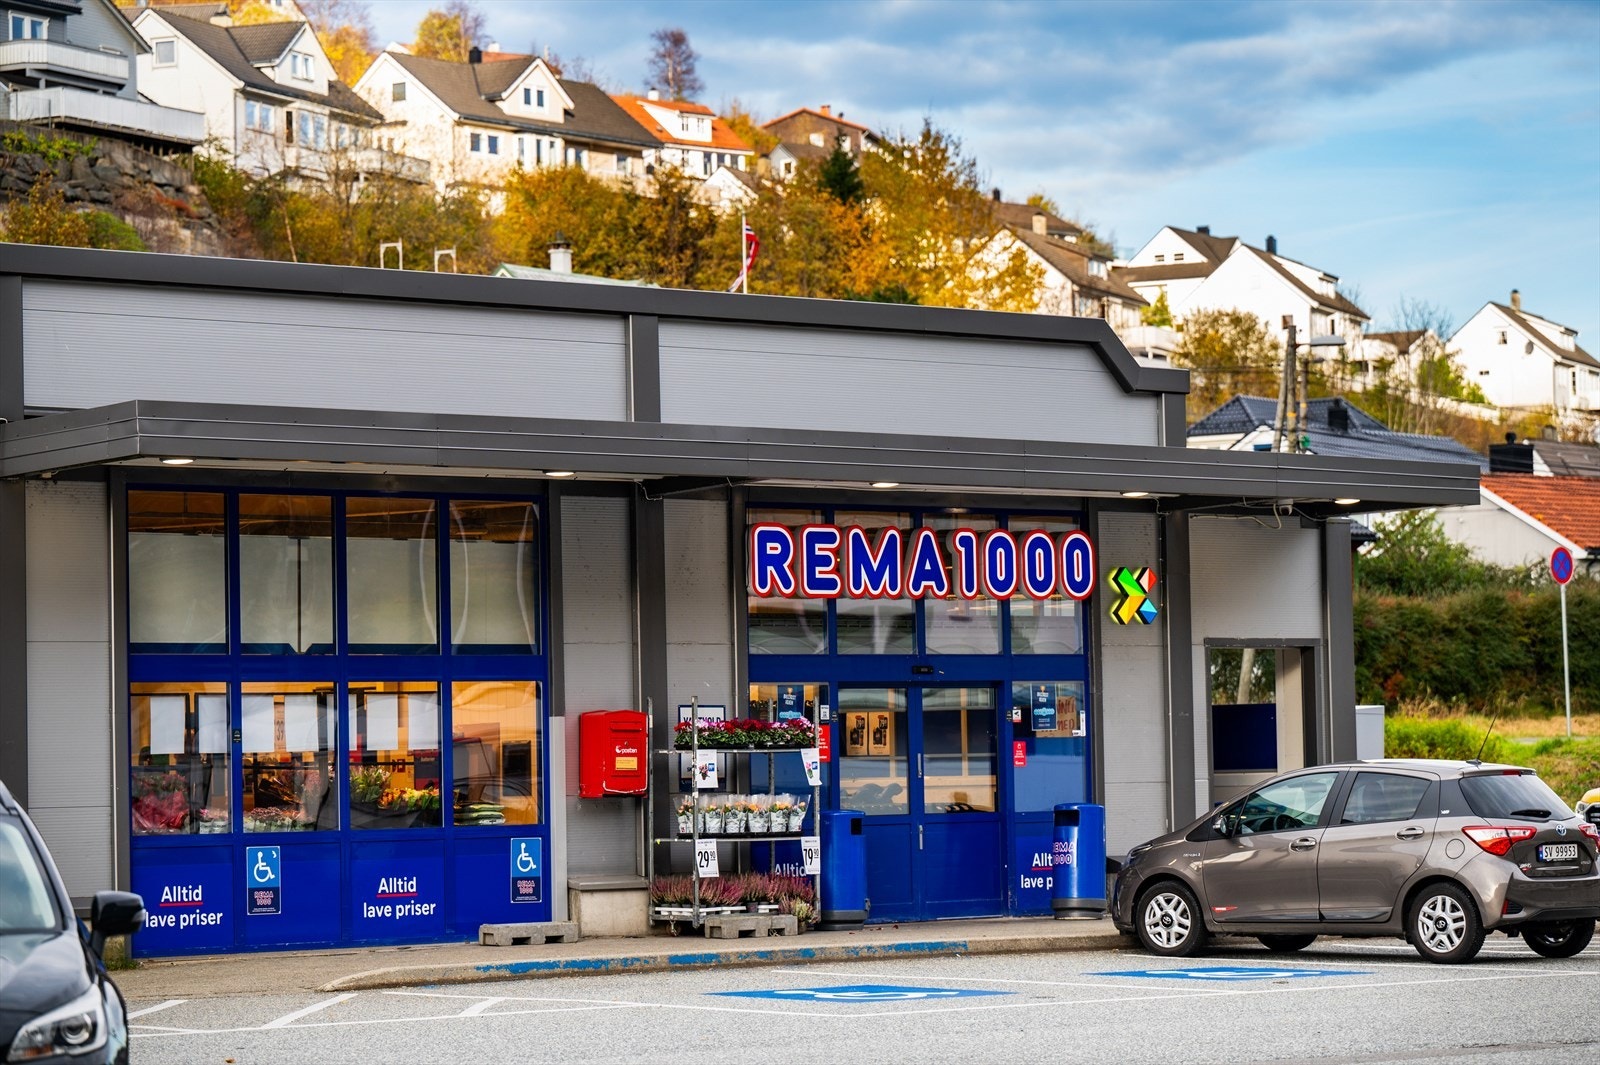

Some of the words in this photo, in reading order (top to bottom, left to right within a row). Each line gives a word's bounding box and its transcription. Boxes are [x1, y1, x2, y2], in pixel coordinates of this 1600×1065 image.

[1053, 841, 1076, 853] EMA
[1544, 846, 1553, 858] SV
[1556, 846, 1576, 857] 99953
[698, 851, 709, 868] 29
[803, 848, 813, 866] 79
[1032, 853, 1053, 867] Allt
[1053, 853, 1073, 865] 000
[378, 876, 417, 894] Alltid
[1021, 874, 1044, 888] lave
[161, 885, 202, 902] Alltid
[363, 902, 392, 918] lave
[396, 900, 437, 919] priser
[145, 911, 176, 928] lave
[180, 909, 223, 930] priser
